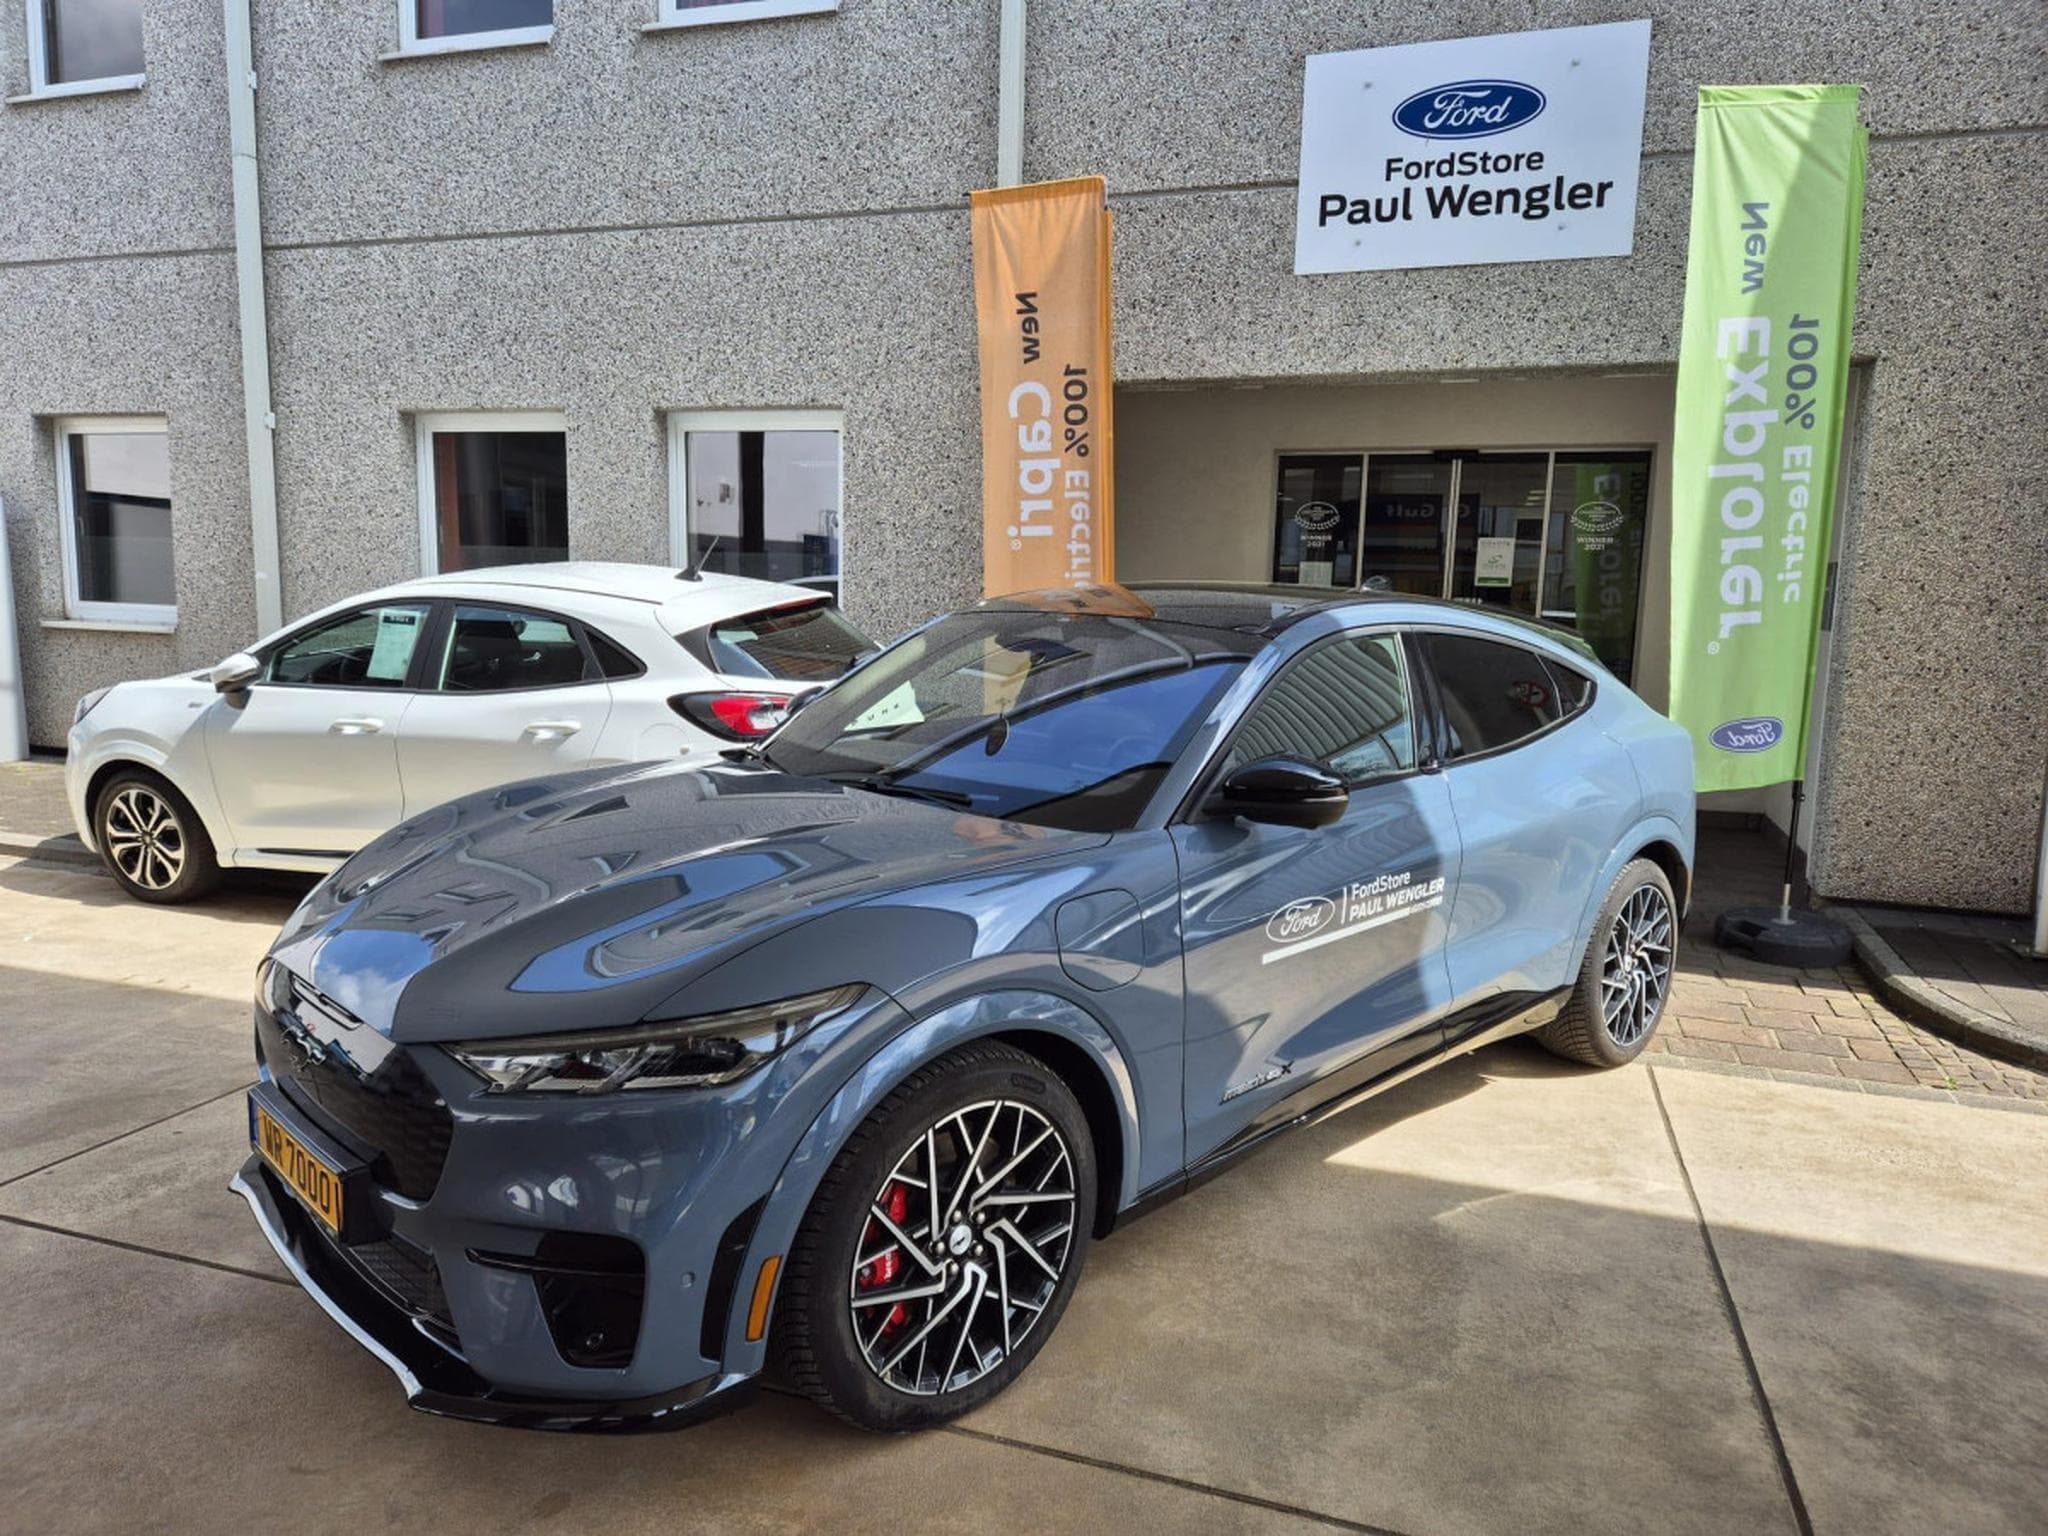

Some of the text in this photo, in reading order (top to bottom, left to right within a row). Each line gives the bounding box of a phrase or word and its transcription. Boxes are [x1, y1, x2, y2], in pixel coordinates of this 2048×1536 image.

[1424, 89, 1512, 129] Ford
[1385, 151, 1544, 181] FordStore
[1318, 175, 1614, 227] Paul Wengler
[1349, 896, 1384, 922] PAUL
[1386, 876, 1445, 910] WENGLER
[1351, 871, 1411, 901] FordStore
[1279, 902, 1322, 936] Ford
[286, 1136, 330, 1215] 7000
